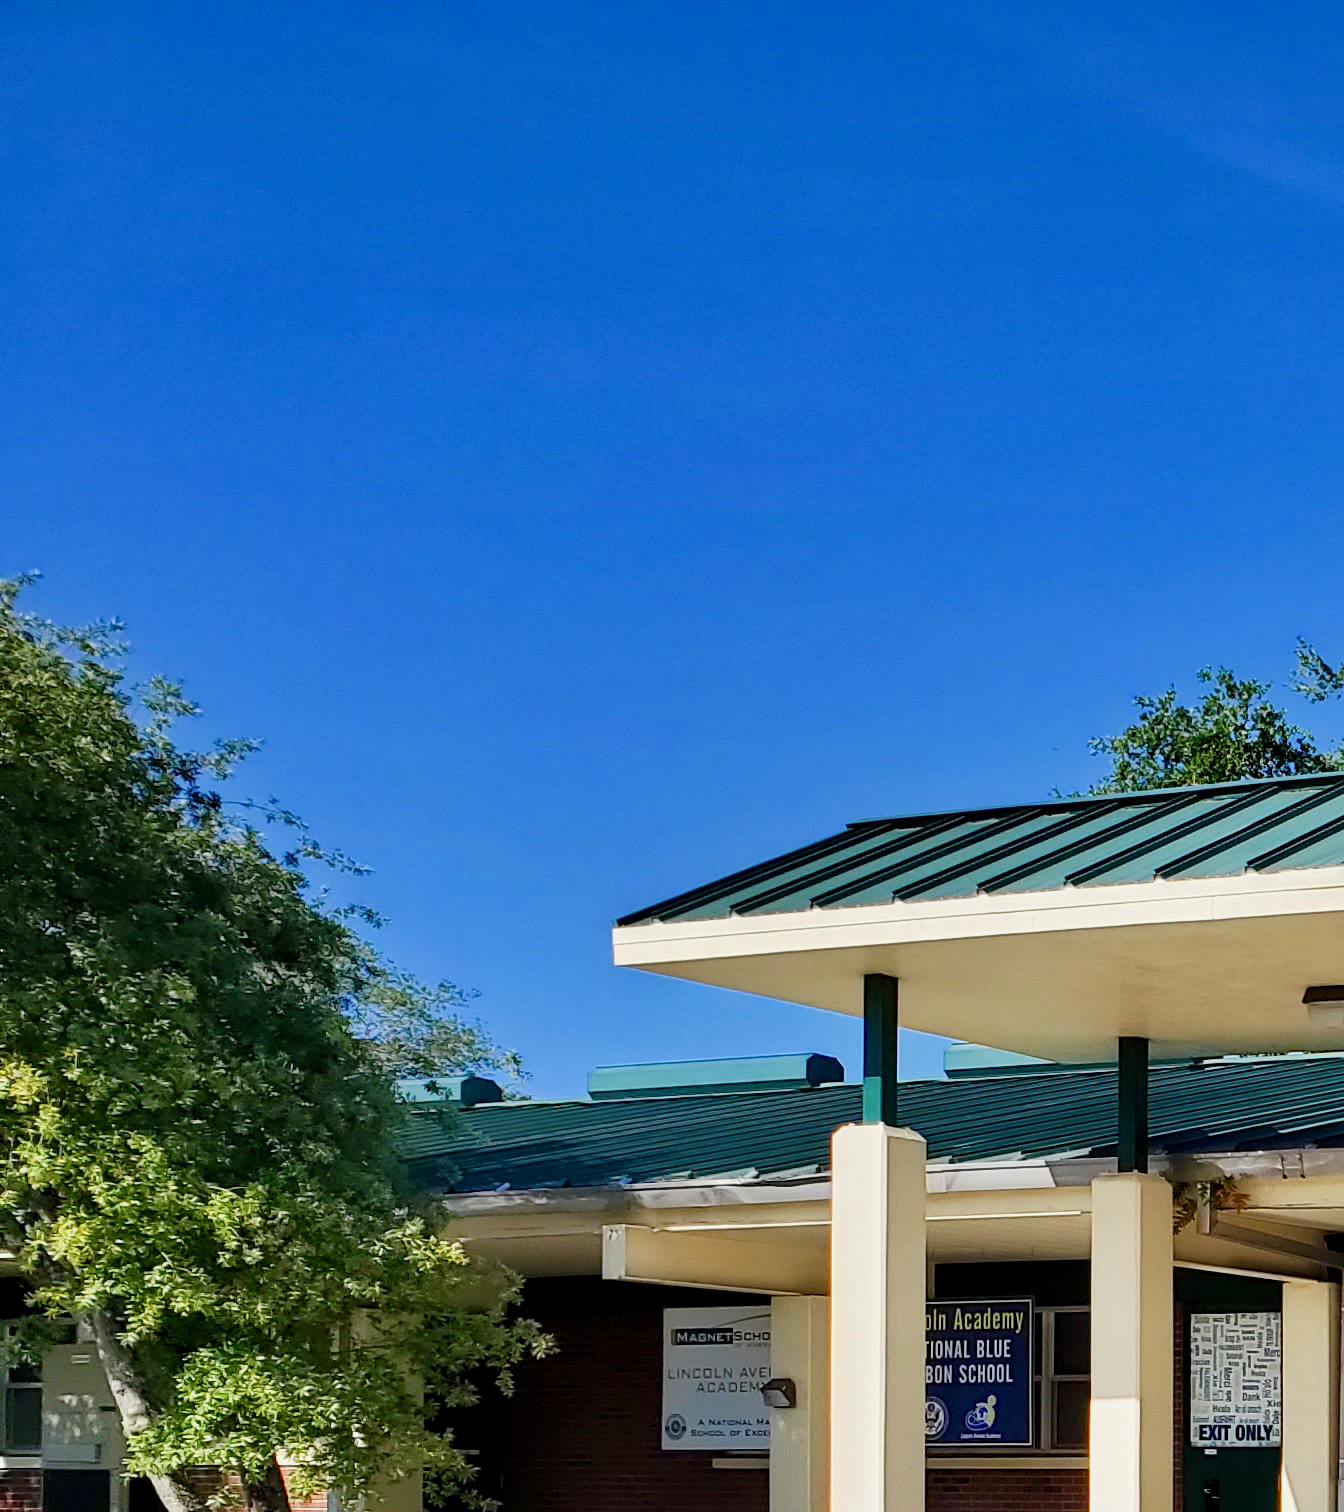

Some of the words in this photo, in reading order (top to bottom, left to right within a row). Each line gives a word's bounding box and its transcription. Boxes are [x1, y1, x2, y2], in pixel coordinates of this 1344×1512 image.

[954, 1307, 1024, 1334] Academy
[976, 1339, 1011, 1358] BLUE
[668, 1367, 733, 1380] LINCOLN
[959, 1364, 1014, 1384] SCHOOL
[691, 1429, 726, 1437] SCHOOL
[1198, 1424, 1232, 1441] EXIT
[1235, 1424, 1274, 1441] ONLY
